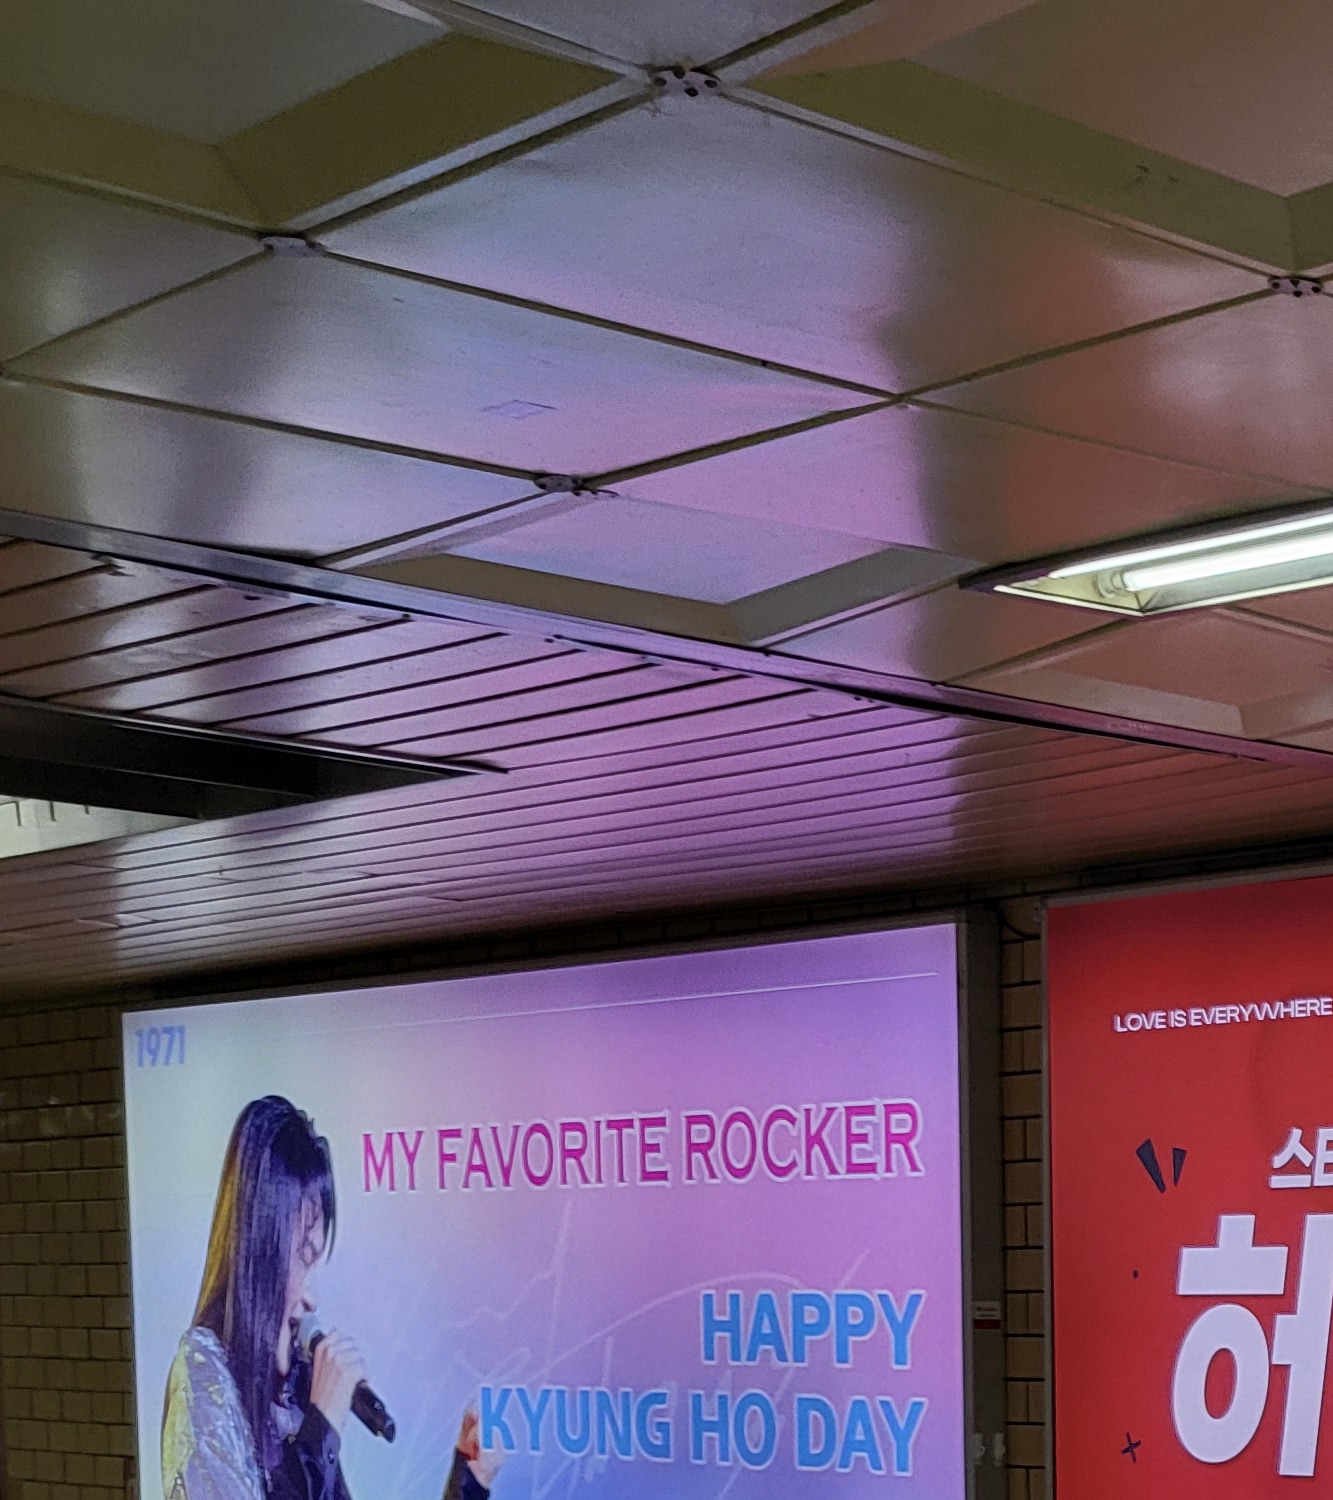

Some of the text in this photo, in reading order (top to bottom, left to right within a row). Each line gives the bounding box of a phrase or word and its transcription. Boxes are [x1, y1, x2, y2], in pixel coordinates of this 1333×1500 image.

[134, 1025, 187, 1068] 1971
[1113, 996, 1333, 1033] LOVE IS EVERYWHERE
[362, 1101, 923, 1192] MY FAVORITE ROCKER
[702, 1292, 924, 1368] HAPPY
[480, 1387, 925, 1476] KYUNG HO DAY
